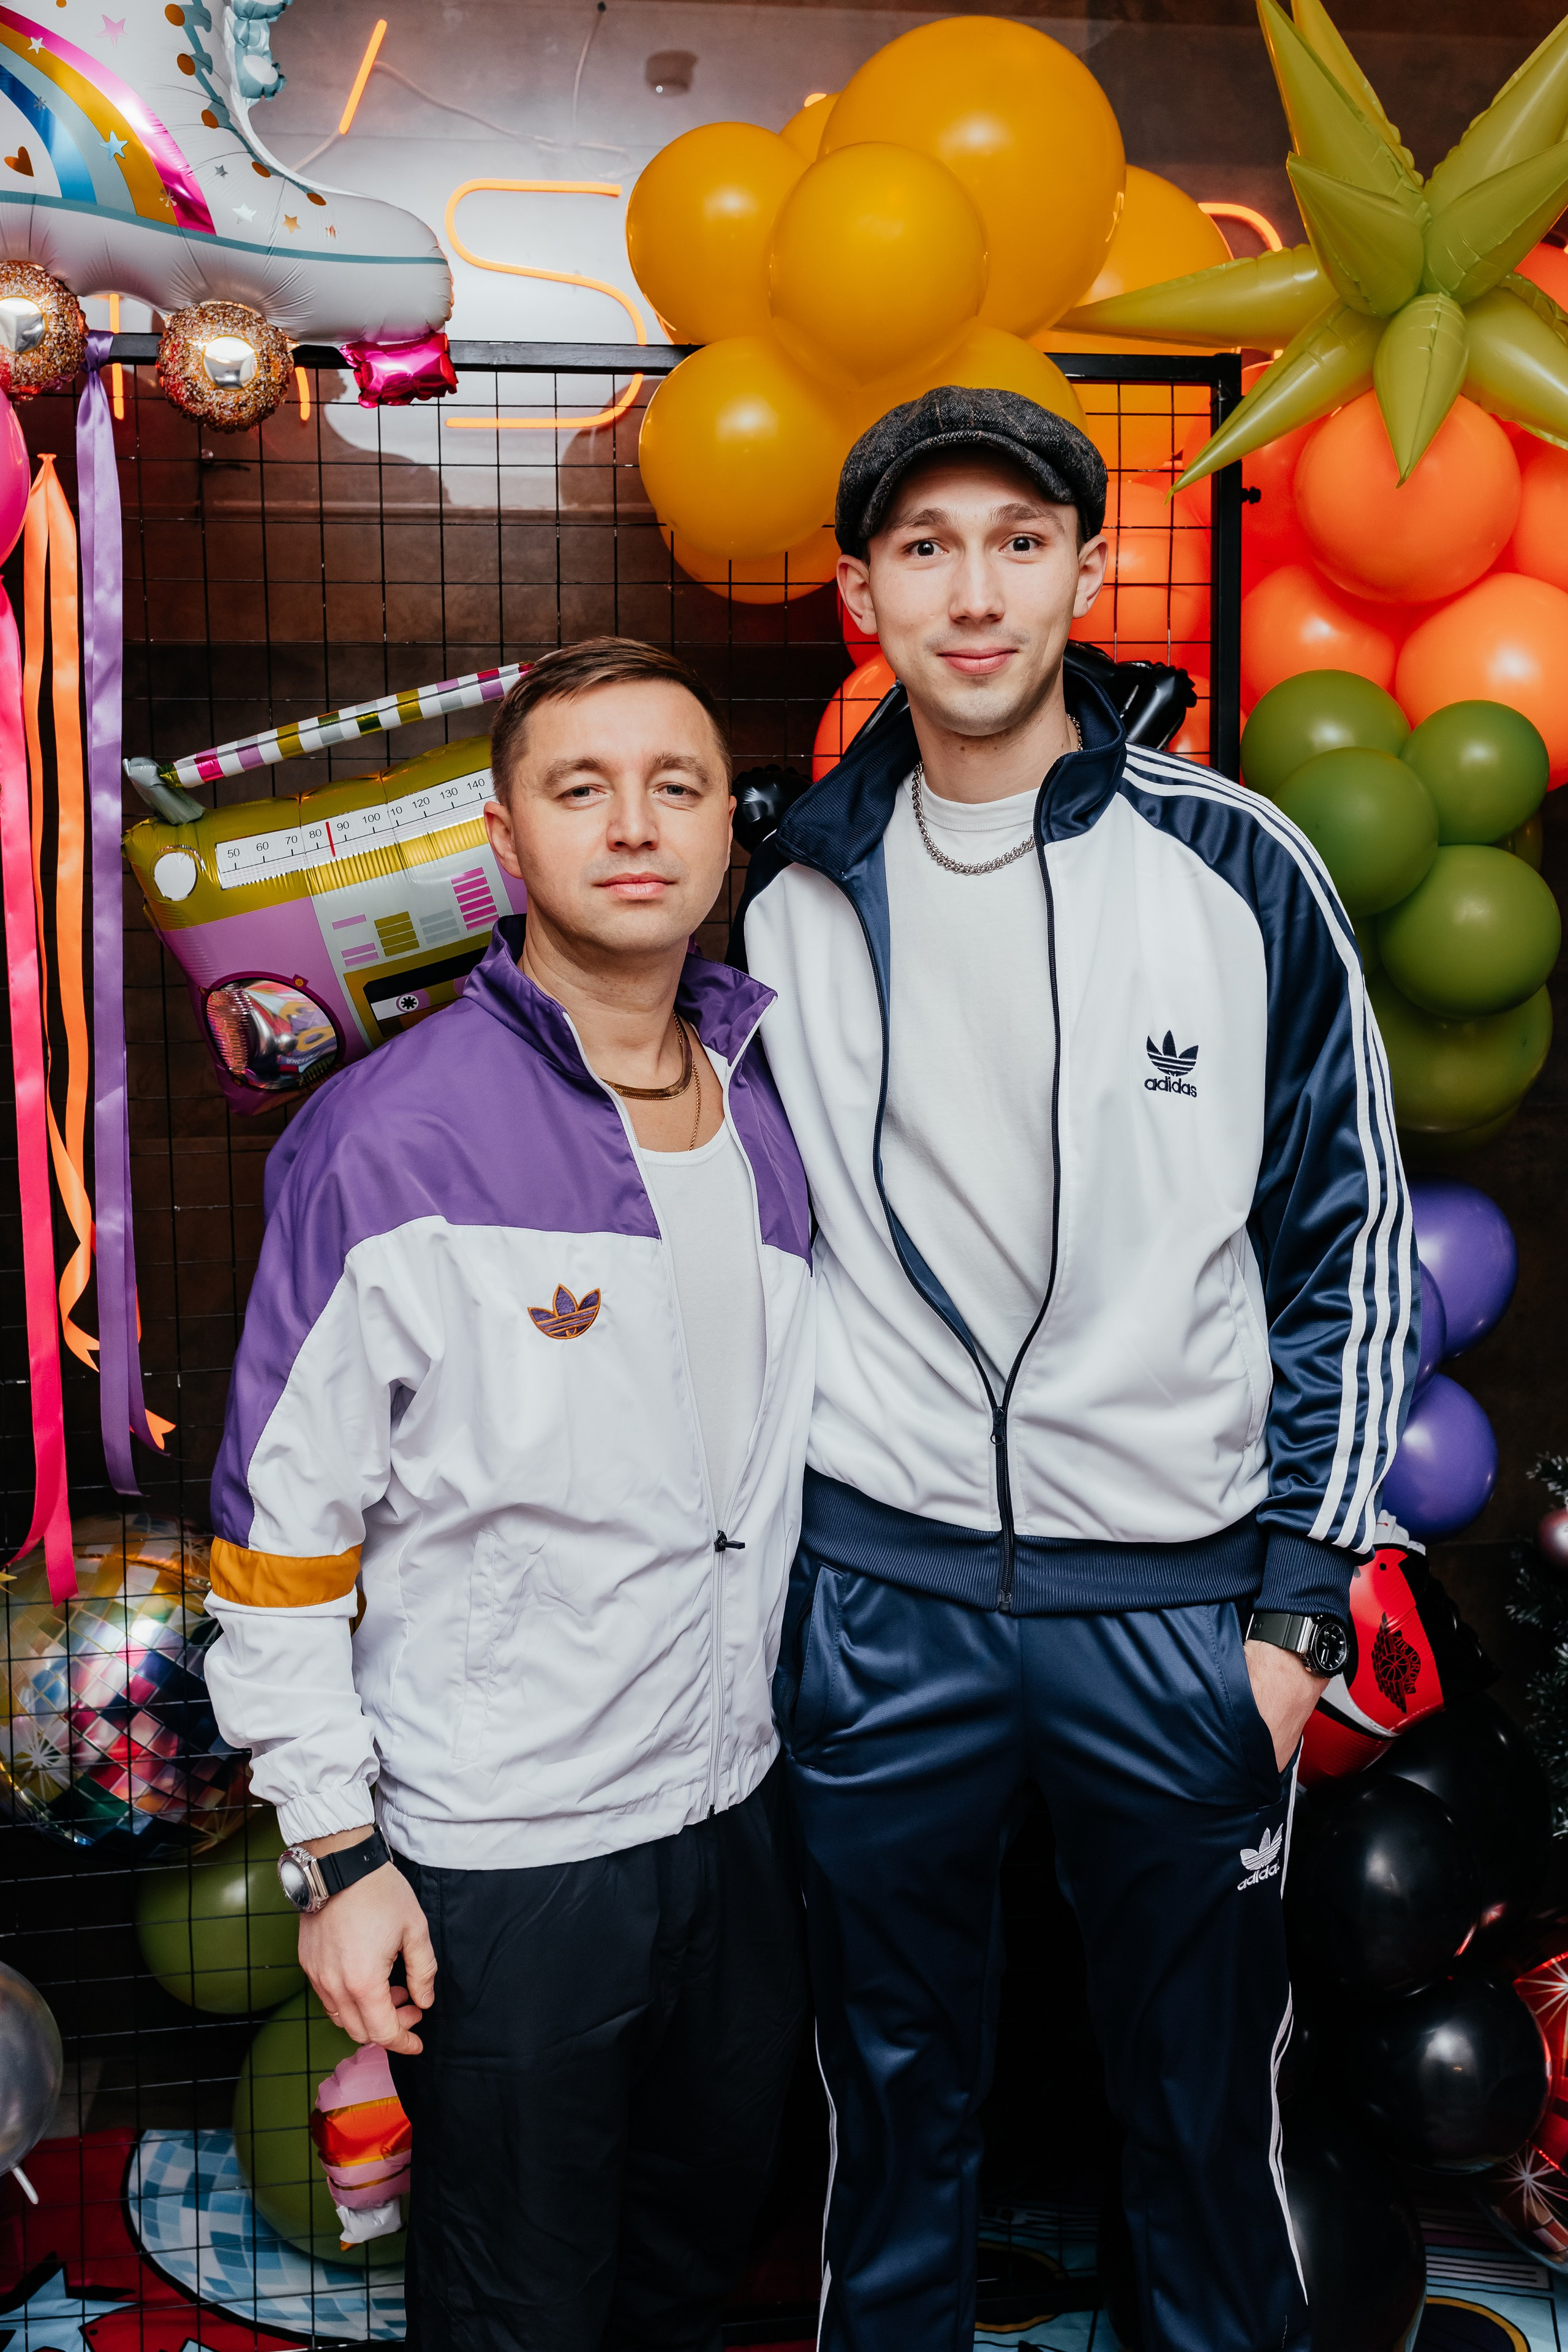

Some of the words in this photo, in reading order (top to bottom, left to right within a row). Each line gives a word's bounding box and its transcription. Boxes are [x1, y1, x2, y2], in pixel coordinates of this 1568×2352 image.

[227, 848, 240, 859] 50
[256, 841, 269, 851] 60
[285, 835, 298, 845] 70
[309, 829, 322, 839] 80
[336, 821, 350, 831] 90
[362, 813, 380, 824] 100
[387, 806, 403, 816] 10
[412, 796, 430, 809] 120
[440, 787, 458, 799] 130
[467, 778, 485, 790] 140
[1144, 1076, 1197, 1098] adidas
[1393, 1636, 1409, 1654] AIR
